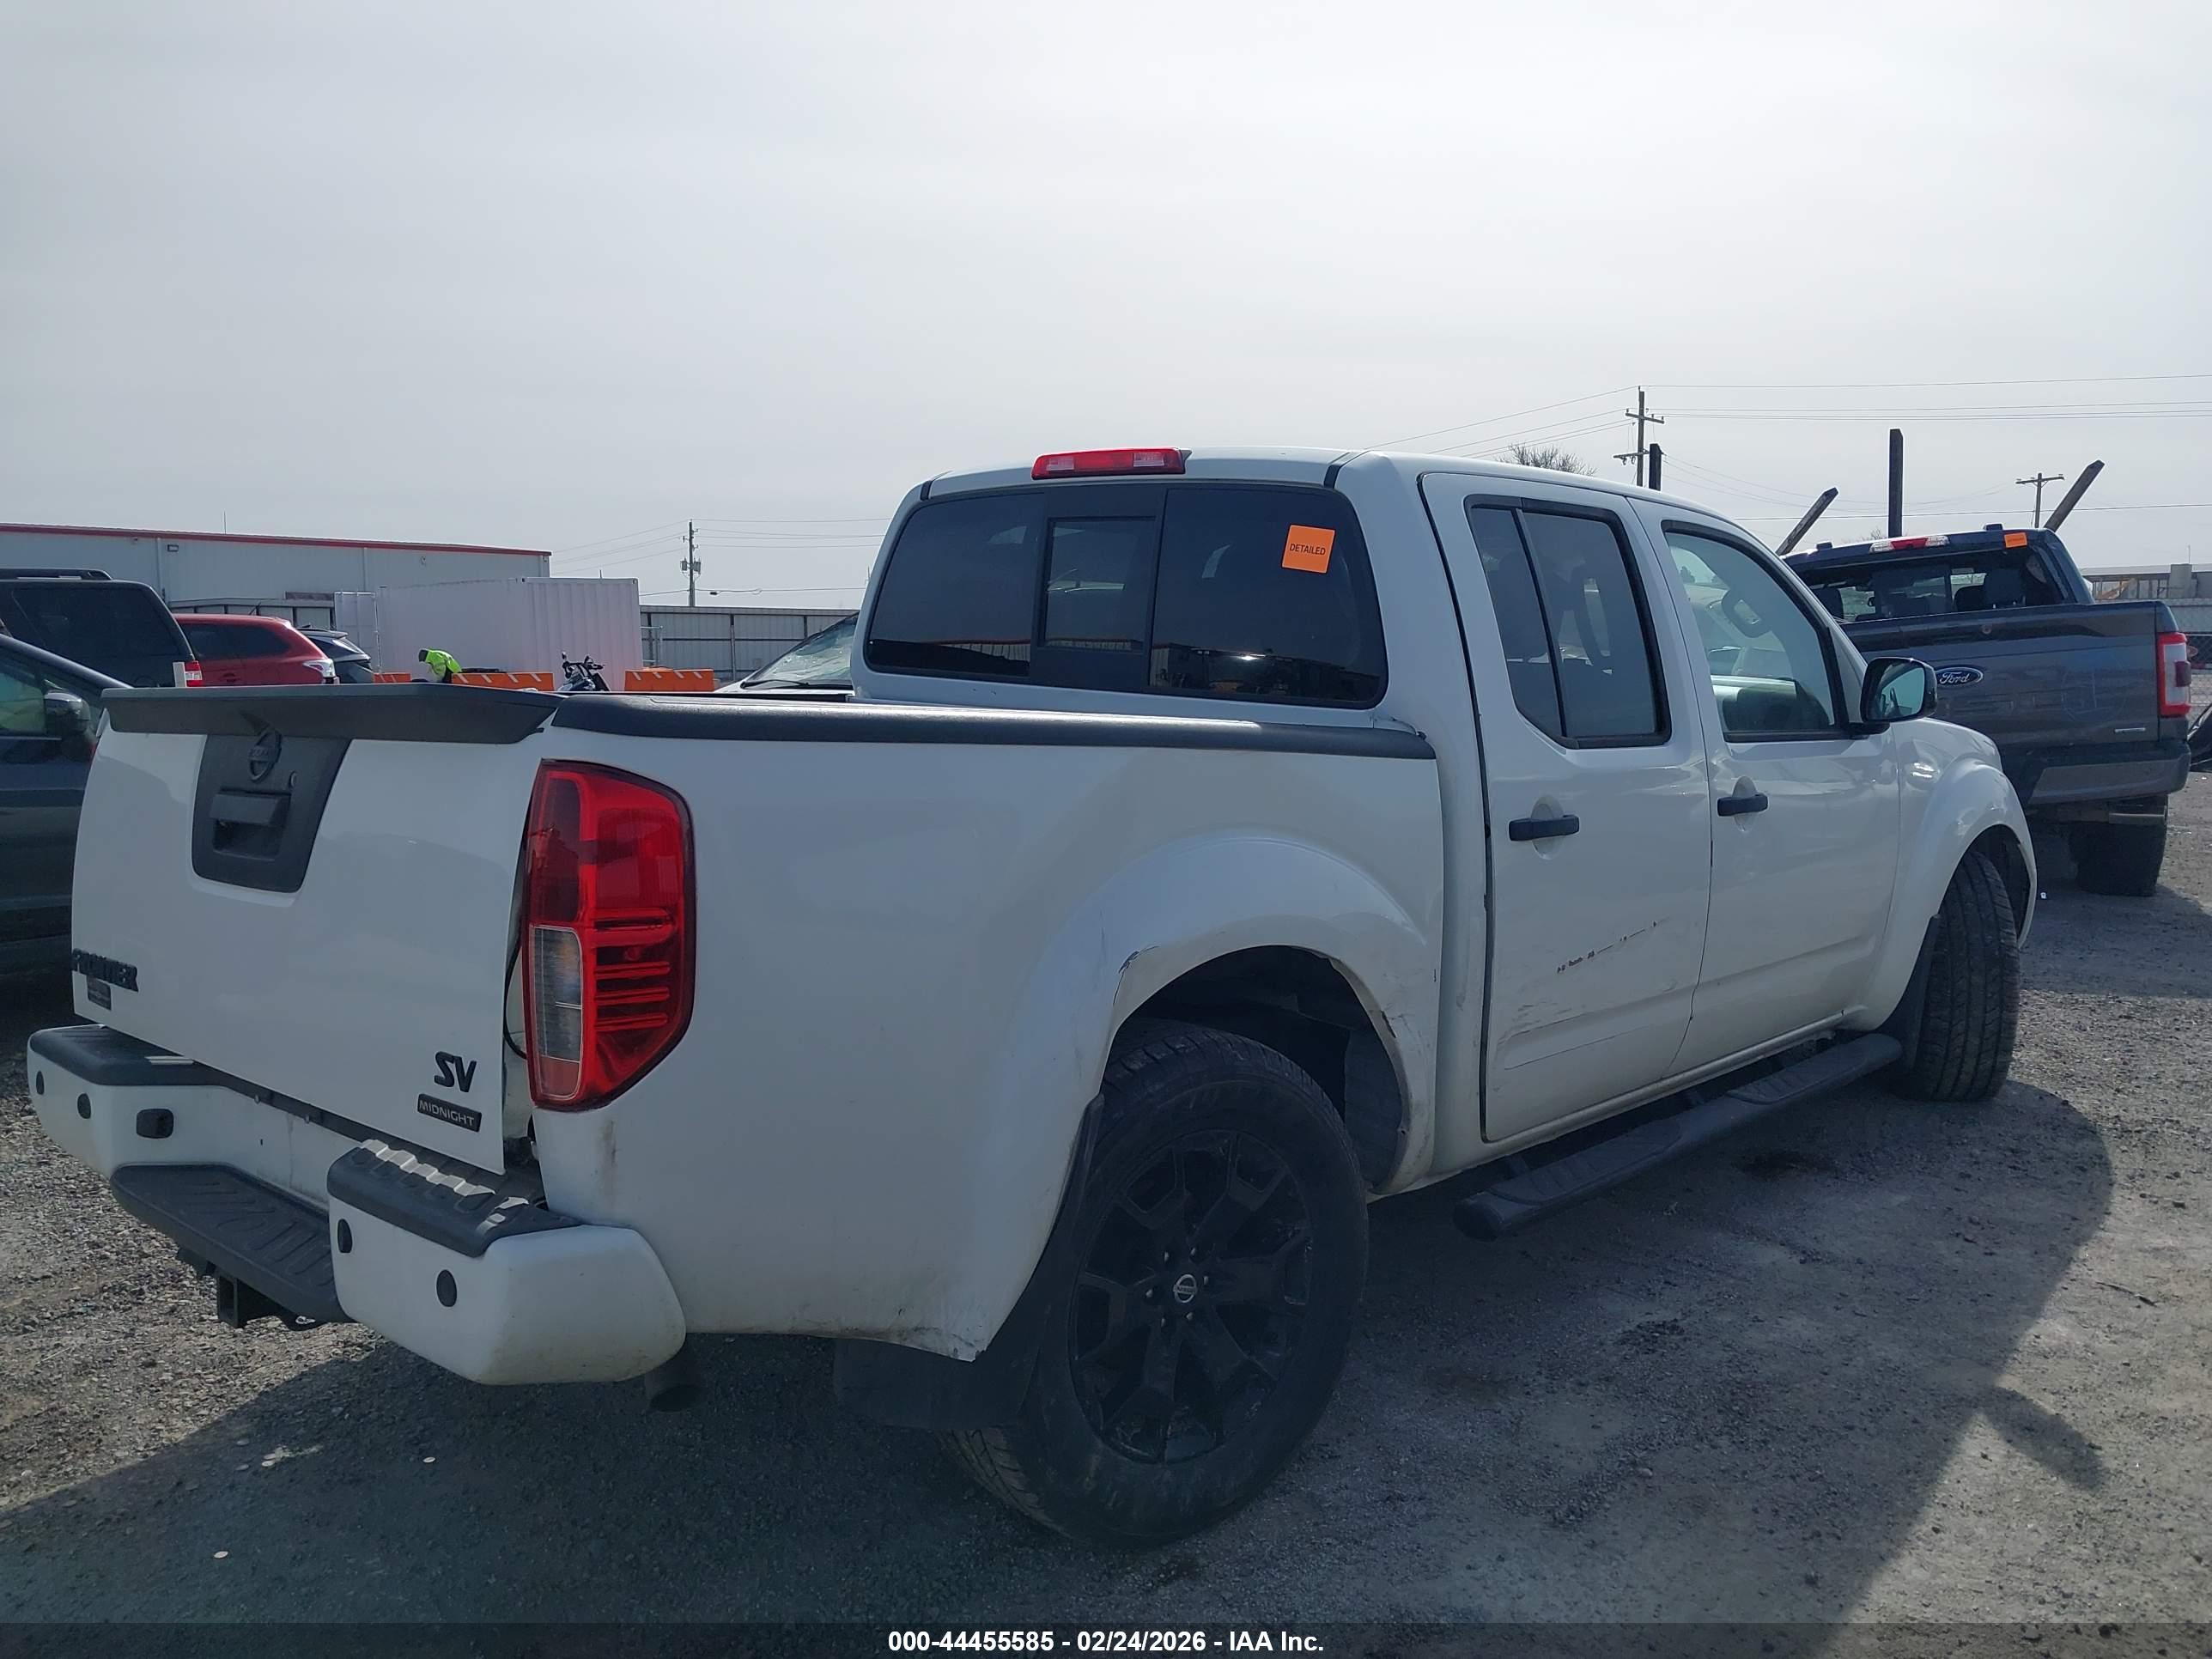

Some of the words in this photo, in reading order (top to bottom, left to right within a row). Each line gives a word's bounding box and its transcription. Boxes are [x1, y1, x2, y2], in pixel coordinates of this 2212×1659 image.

[1289, 543, 1327, 556] DETAILED
[1939, 672, 1971, 684] Ford
[434, 1050, 477, 1093] SV
[419, 1099, 475, 1127] MIDNIGHT
